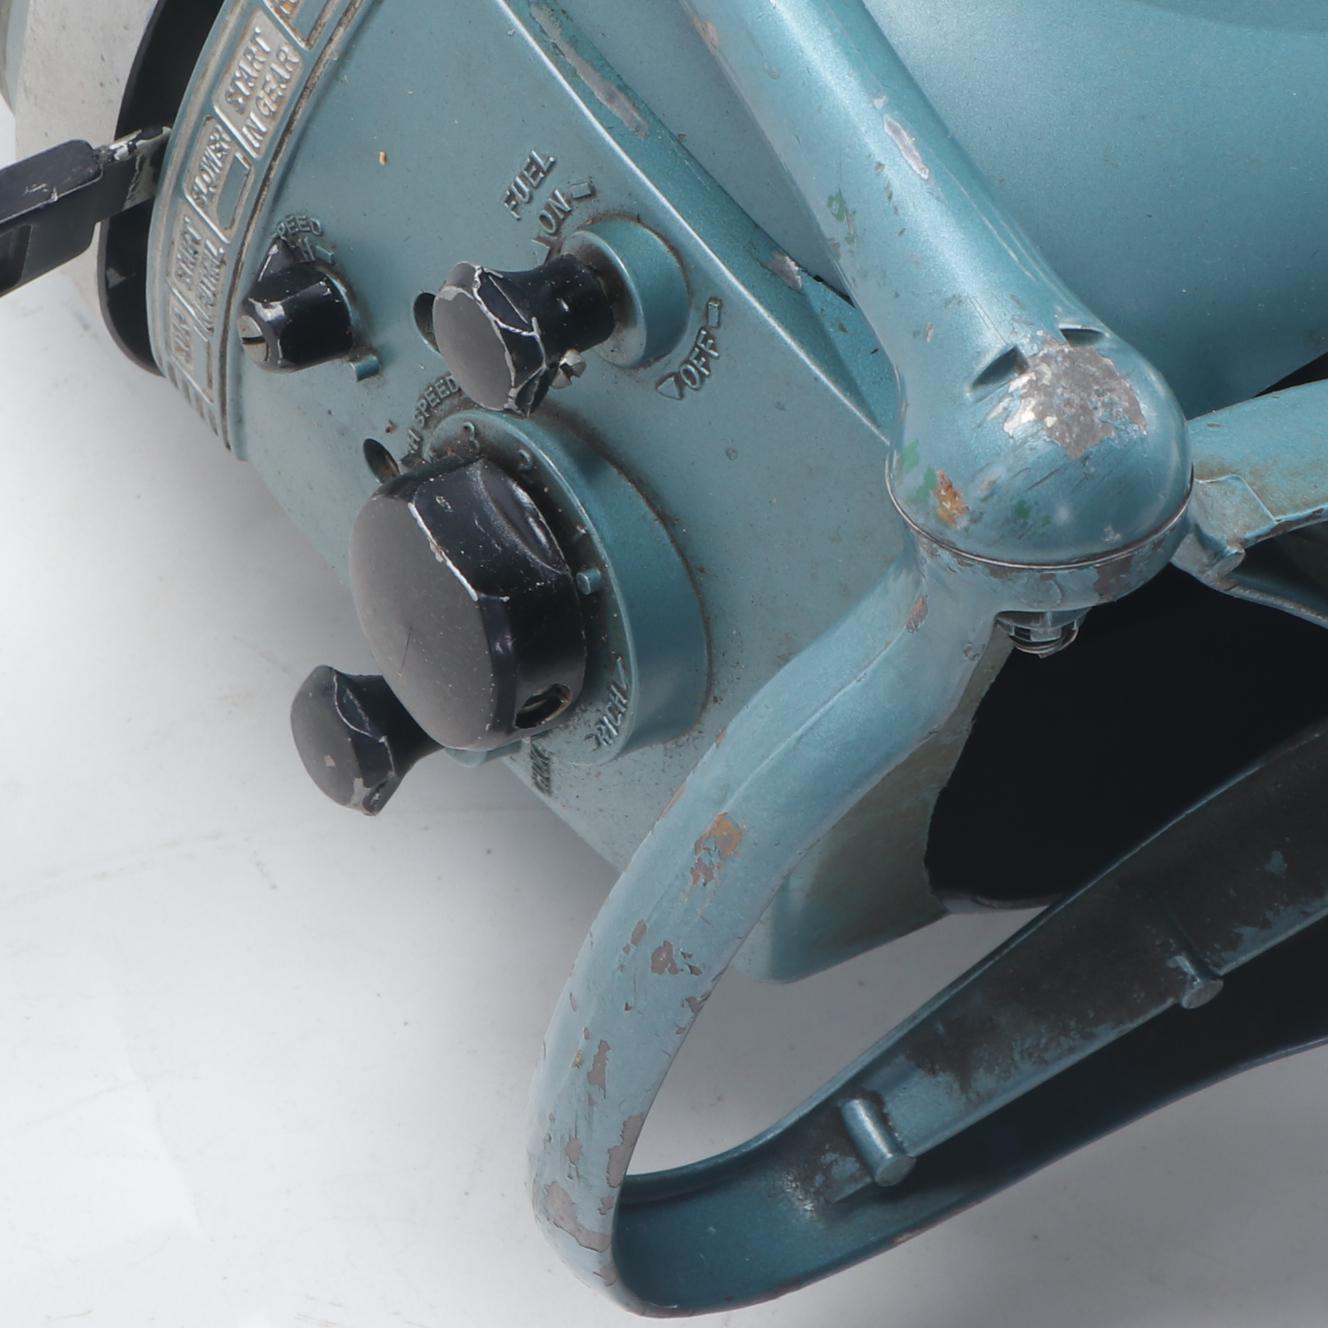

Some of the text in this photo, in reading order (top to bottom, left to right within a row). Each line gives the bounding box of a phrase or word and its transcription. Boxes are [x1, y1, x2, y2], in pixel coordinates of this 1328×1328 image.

[225, 26, 271, 115] START
[242, 43, 300, 159] IN GEAR
[191, 124, 233, 207] SLOWER
[503, 149, 557, 221] FUEL
[274, 214, 323, 239] PEED
[537, 188, 573, 236] ON
[679, 327, 721, 391] OFF
[414, 374, 460, 428] SPEED
